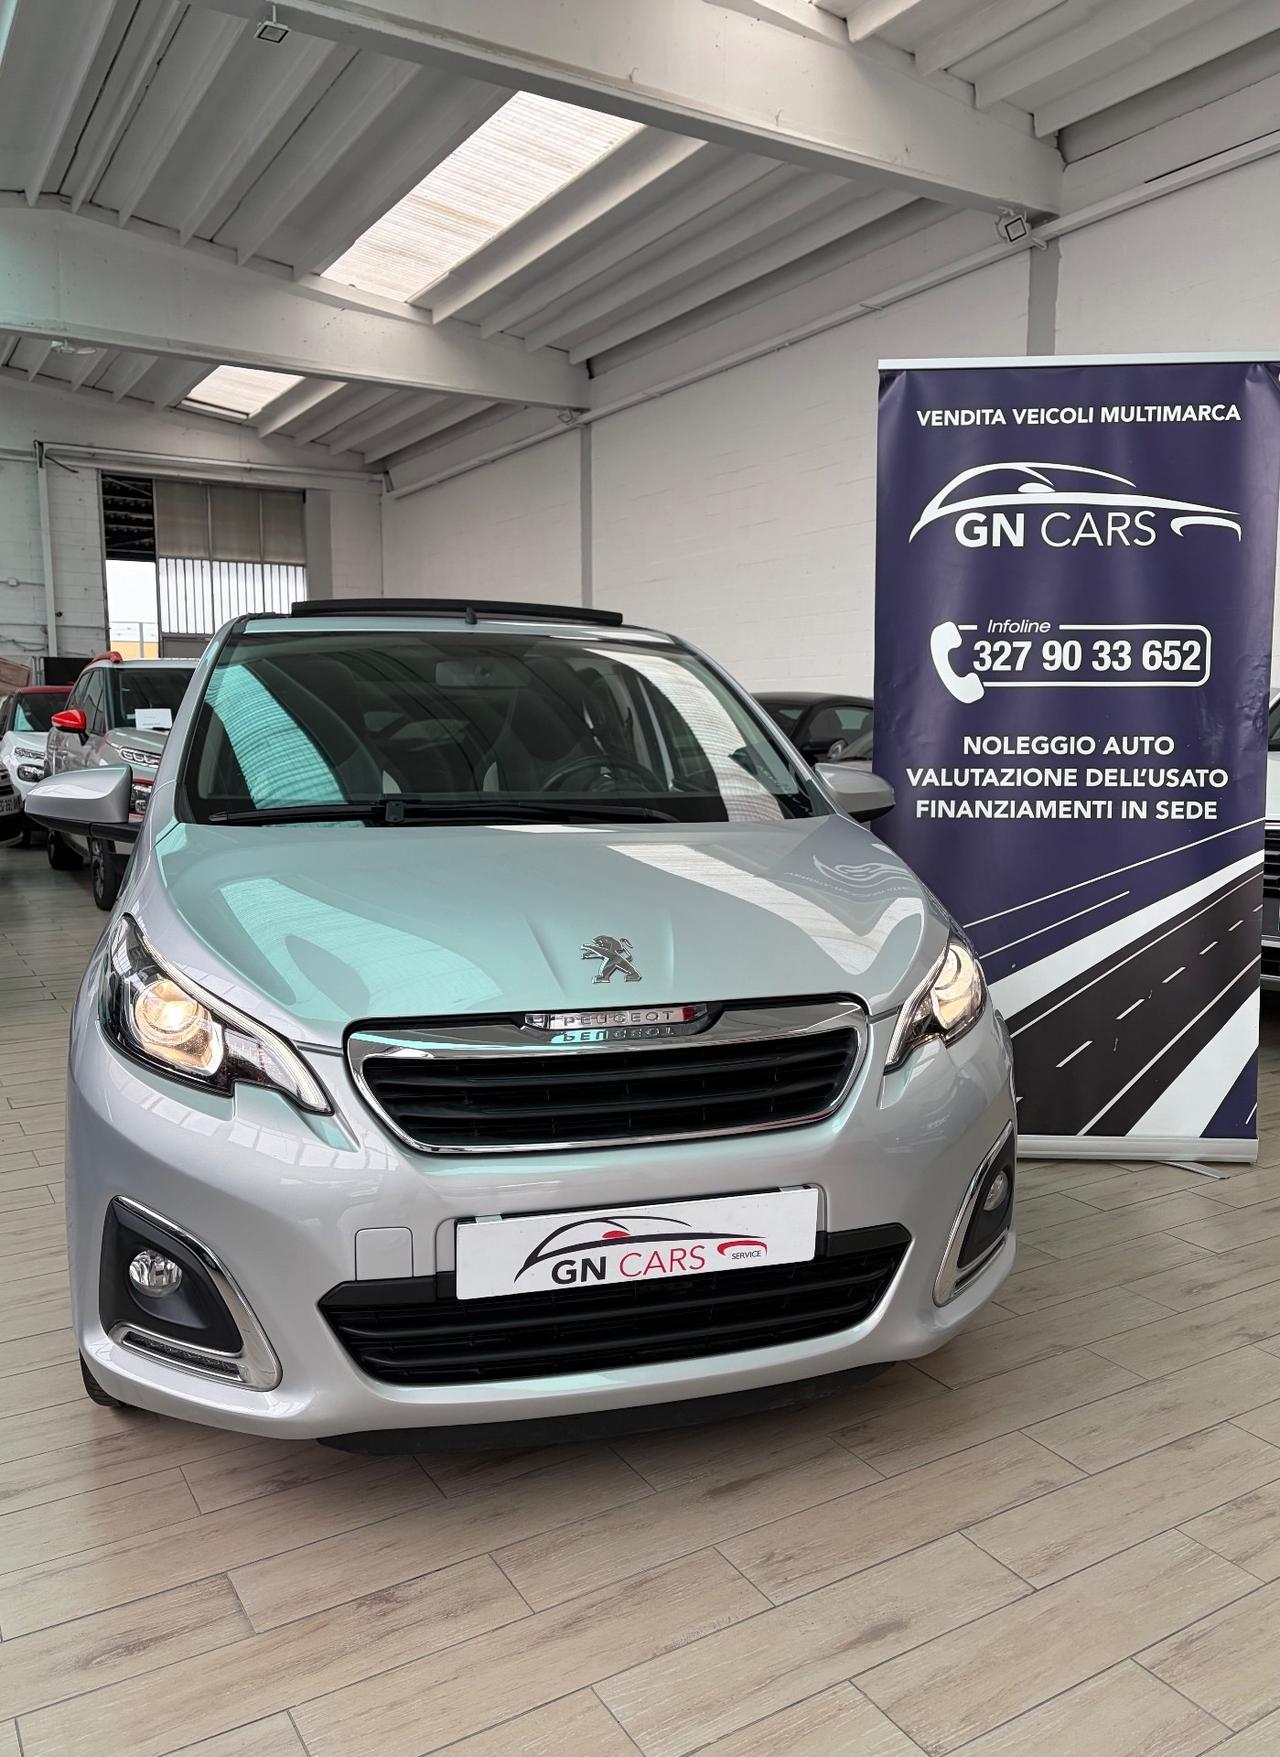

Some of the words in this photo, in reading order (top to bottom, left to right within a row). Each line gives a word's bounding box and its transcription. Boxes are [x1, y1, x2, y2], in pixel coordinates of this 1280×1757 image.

[916, 408, 1007, 427] VENDITA
[1012, 406, 1094, 425] VEICOLI
[1100, 404, 1242, 423] MULTIMARCA
[954, 512, 1025, 548] GN
[1040, 510, 1157, 548] CARS
[986, 618, 1051, 634] Infoline
[972, 640, 1032, 672] 327
[1041, 640, 1082, 672] 90
[1091, 640, 1132, 672] 33
[1142, 639, 1201, 671] 652
[963, 735, 1096, 756] NOLEGGIO
[1102, 735, 1176, 756] AUTO
[906, 767, 1078, 788] VALUTAZIONE
[916, 799, 1113, 819] FINANZIAMENTI
[1121, 800, 1147, 819] IN
[1155, 800, 1218, 820] SEDE
[563, 1010, 674, 1026] PEUGEOT
[552, 1256, 606, 1285] GN
[619, 1246, 706, 1277] CARS
[731, 1250, 762, 1260] SERVICE
